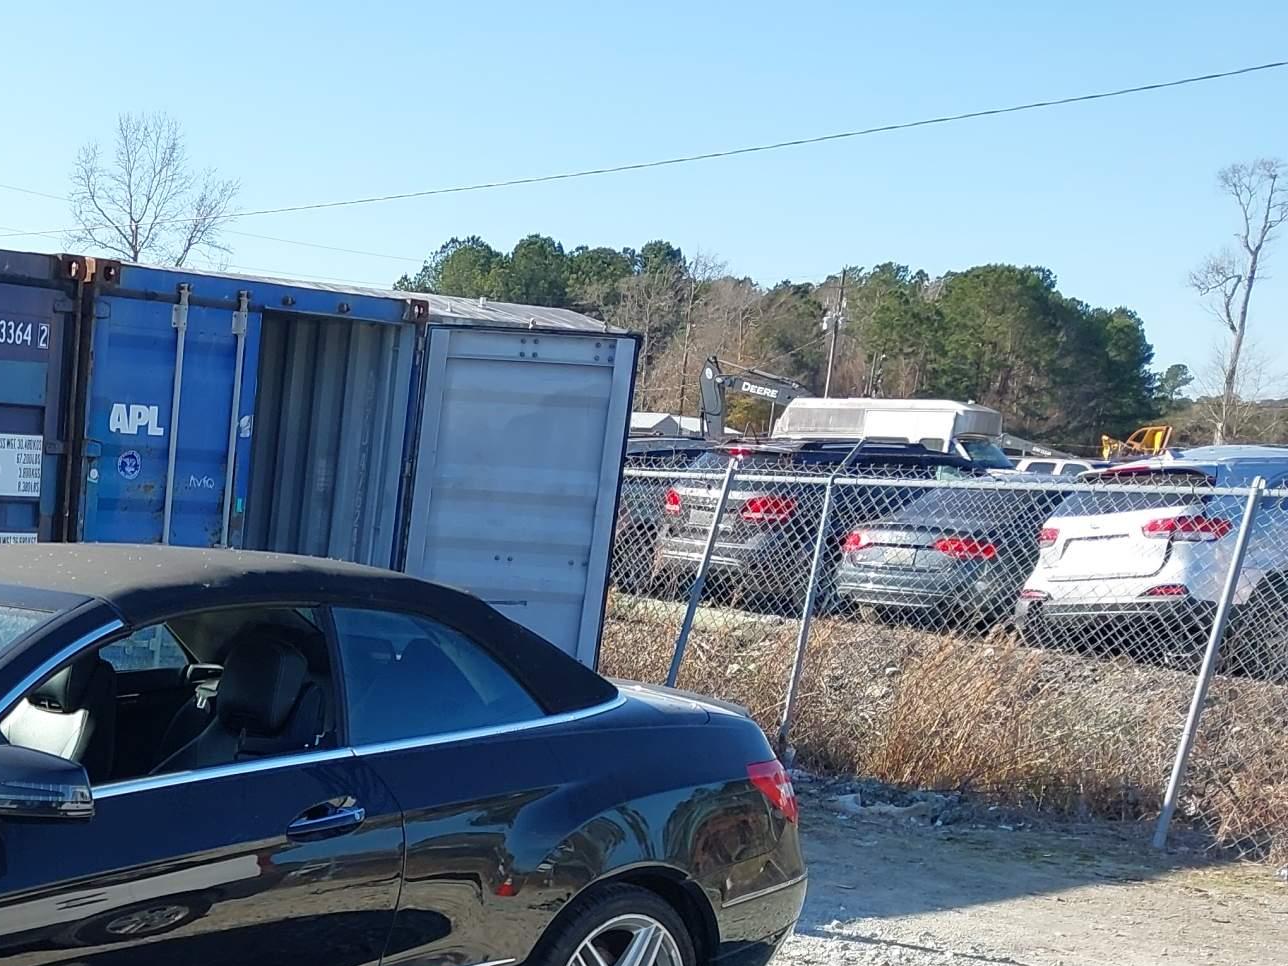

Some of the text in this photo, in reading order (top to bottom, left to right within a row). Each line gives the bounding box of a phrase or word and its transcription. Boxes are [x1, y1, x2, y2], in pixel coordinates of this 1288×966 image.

[39, 325, 49, 348] 2
[742, 381, 779, 398] DEERE
[110, 403, 164, 436] APL
